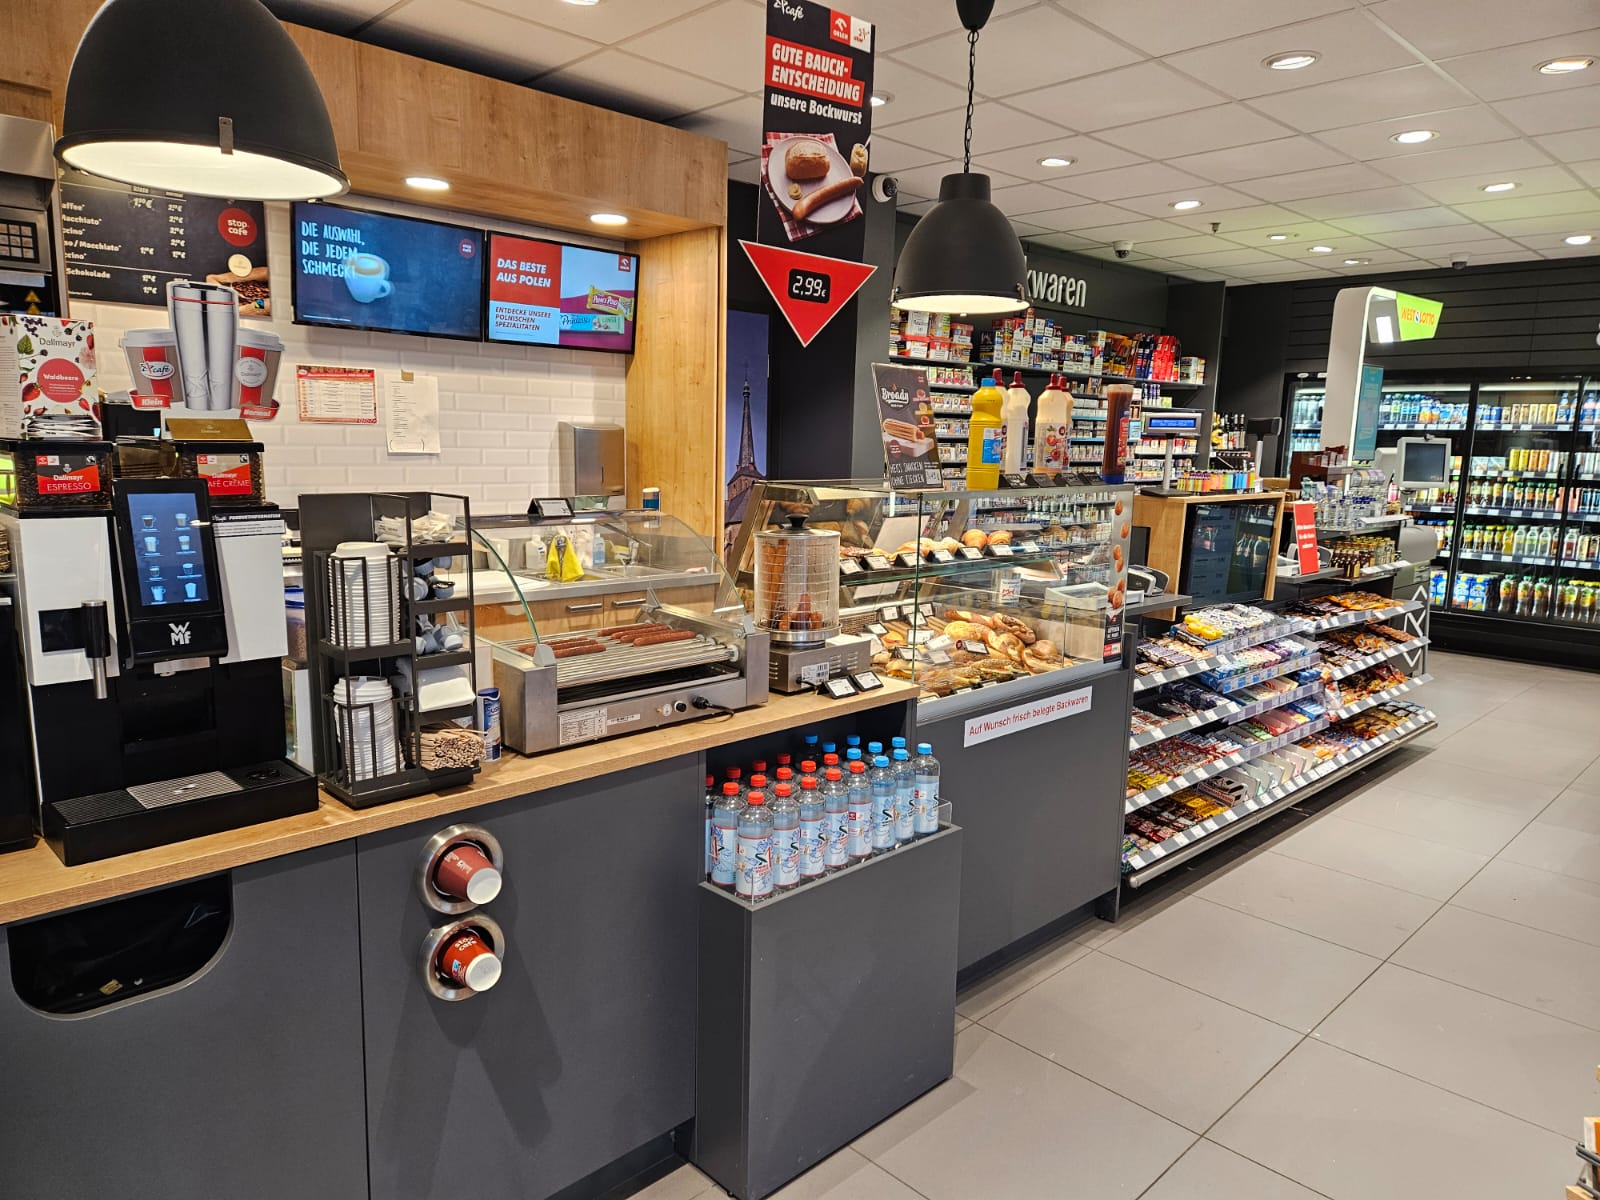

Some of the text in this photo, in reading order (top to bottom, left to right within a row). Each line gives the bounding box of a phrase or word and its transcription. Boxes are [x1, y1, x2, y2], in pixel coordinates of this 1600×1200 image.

[772, 43, 849, 77] GUTE BAUCH-
[771, 65, 861, 102] ENTSCHEIDUNG
[770, 93, 863, 125] unsere Bockwurst
[227, 219, 248, 229] stop
[228, 227, 249, 236] cafe
[301, 220, 319, 238] DIE
[301, 240, 358, 260] DIE JEDEM
[497, 257, 547, 275] DAS BESTE
[496, 271, 552, 288] AUS POLEN
[495, 306, 552, 319] ENTDECKE UNSERE
[495, 314, 536, 324] POLNISCHEN
[39, 337, 76, 348] Dallmayr
[881, 387, 909, 404] Broady
[53, 474, 84, 482] Dallmayr
[47, 482, 92, 492] ESPRESSO
[168, 621, 191, 645] WMF
[969, 695, 1089, 735] Auf Wunsch frisch belegte Backwaren
